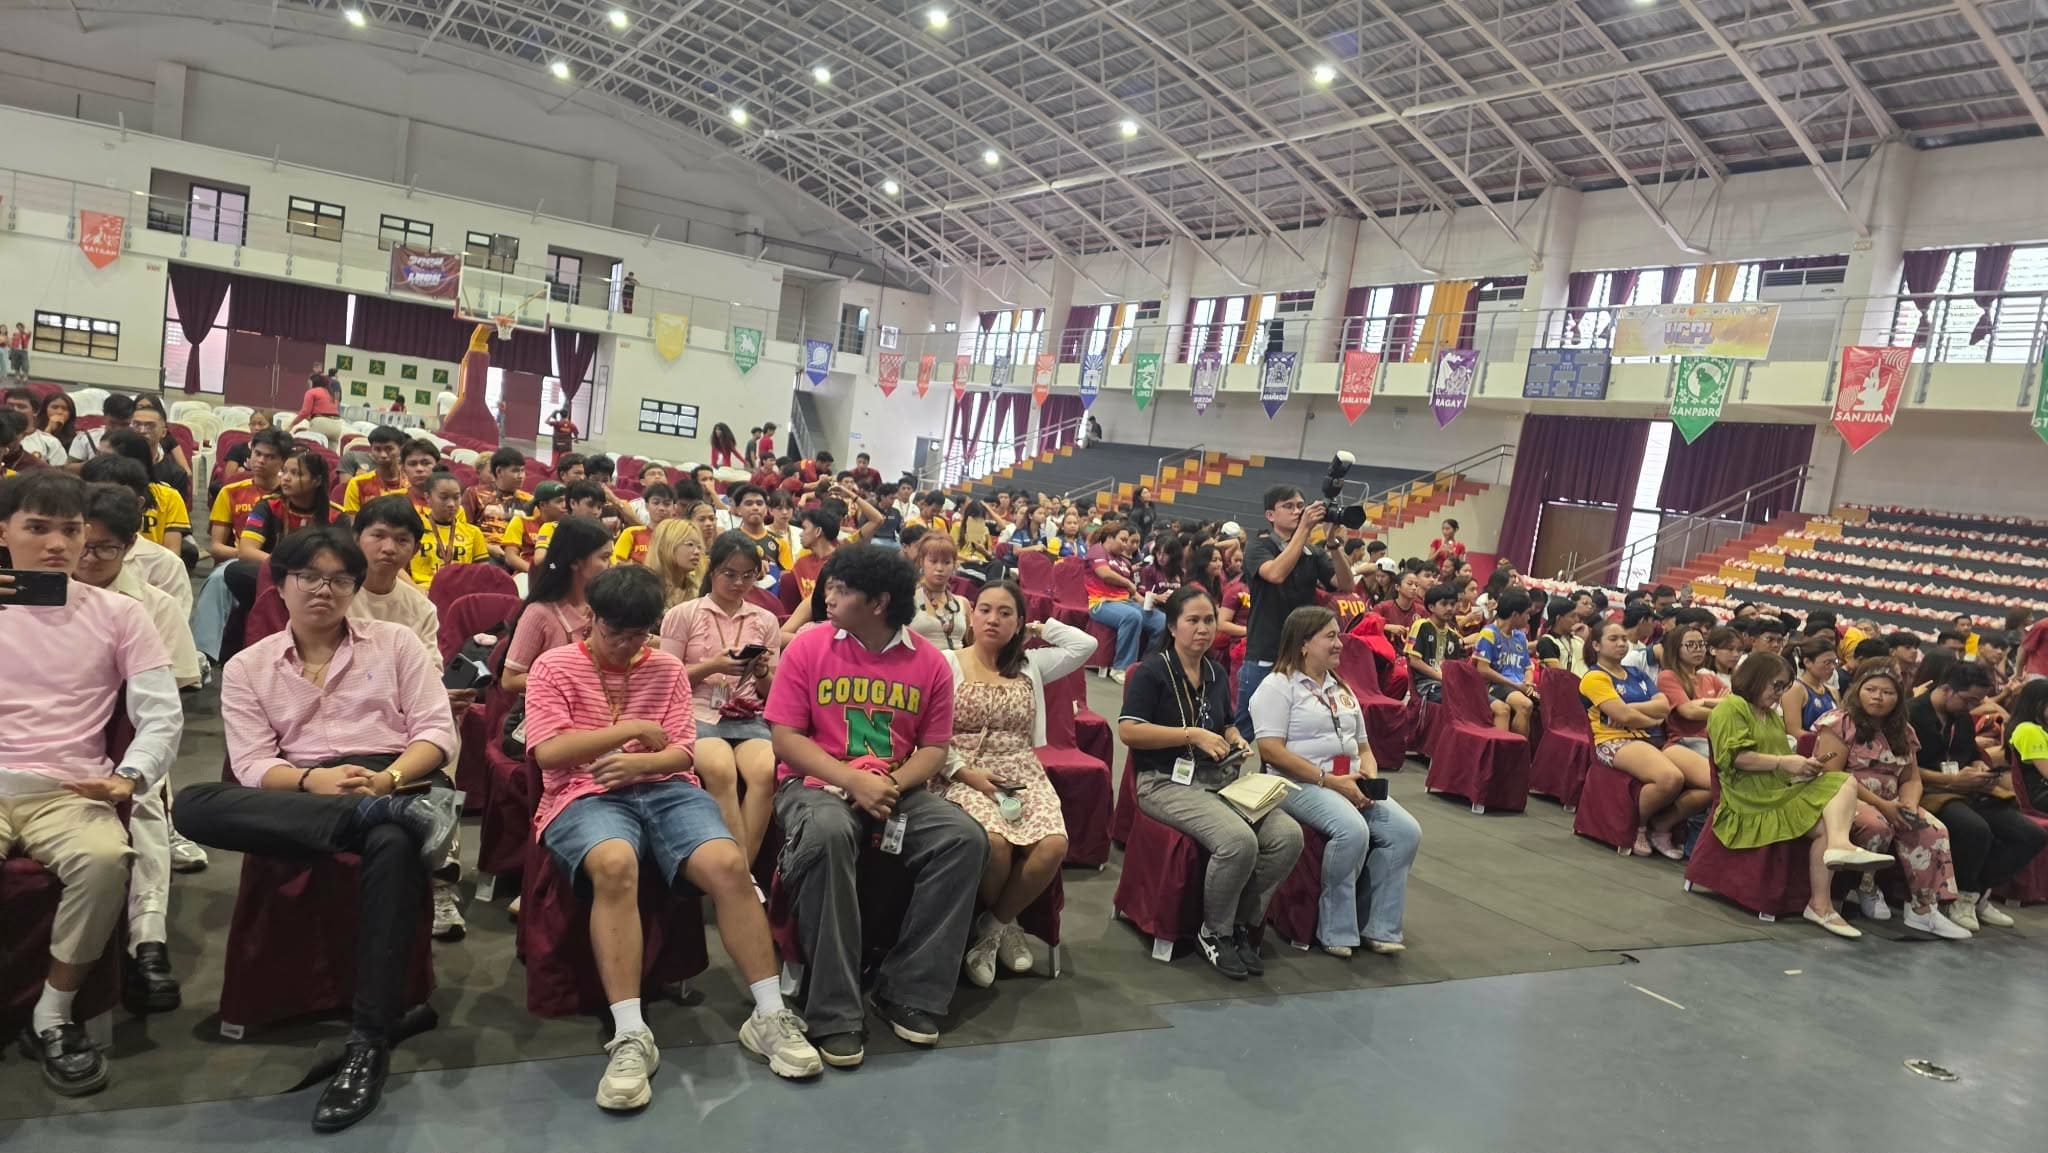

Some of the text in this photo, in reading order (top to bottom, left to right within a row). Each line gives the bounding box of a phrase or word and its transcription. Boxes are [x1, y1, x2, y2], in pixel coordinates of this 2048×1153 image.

[1435, 398, 1462, 408] RAGAY
[1835, 411, 1893, 424] SAN JUAN
[1336, 599, 1366, 617] PUP
[817, 676, 921, 715] COUGAR
[844, 705, 895, 759] N
